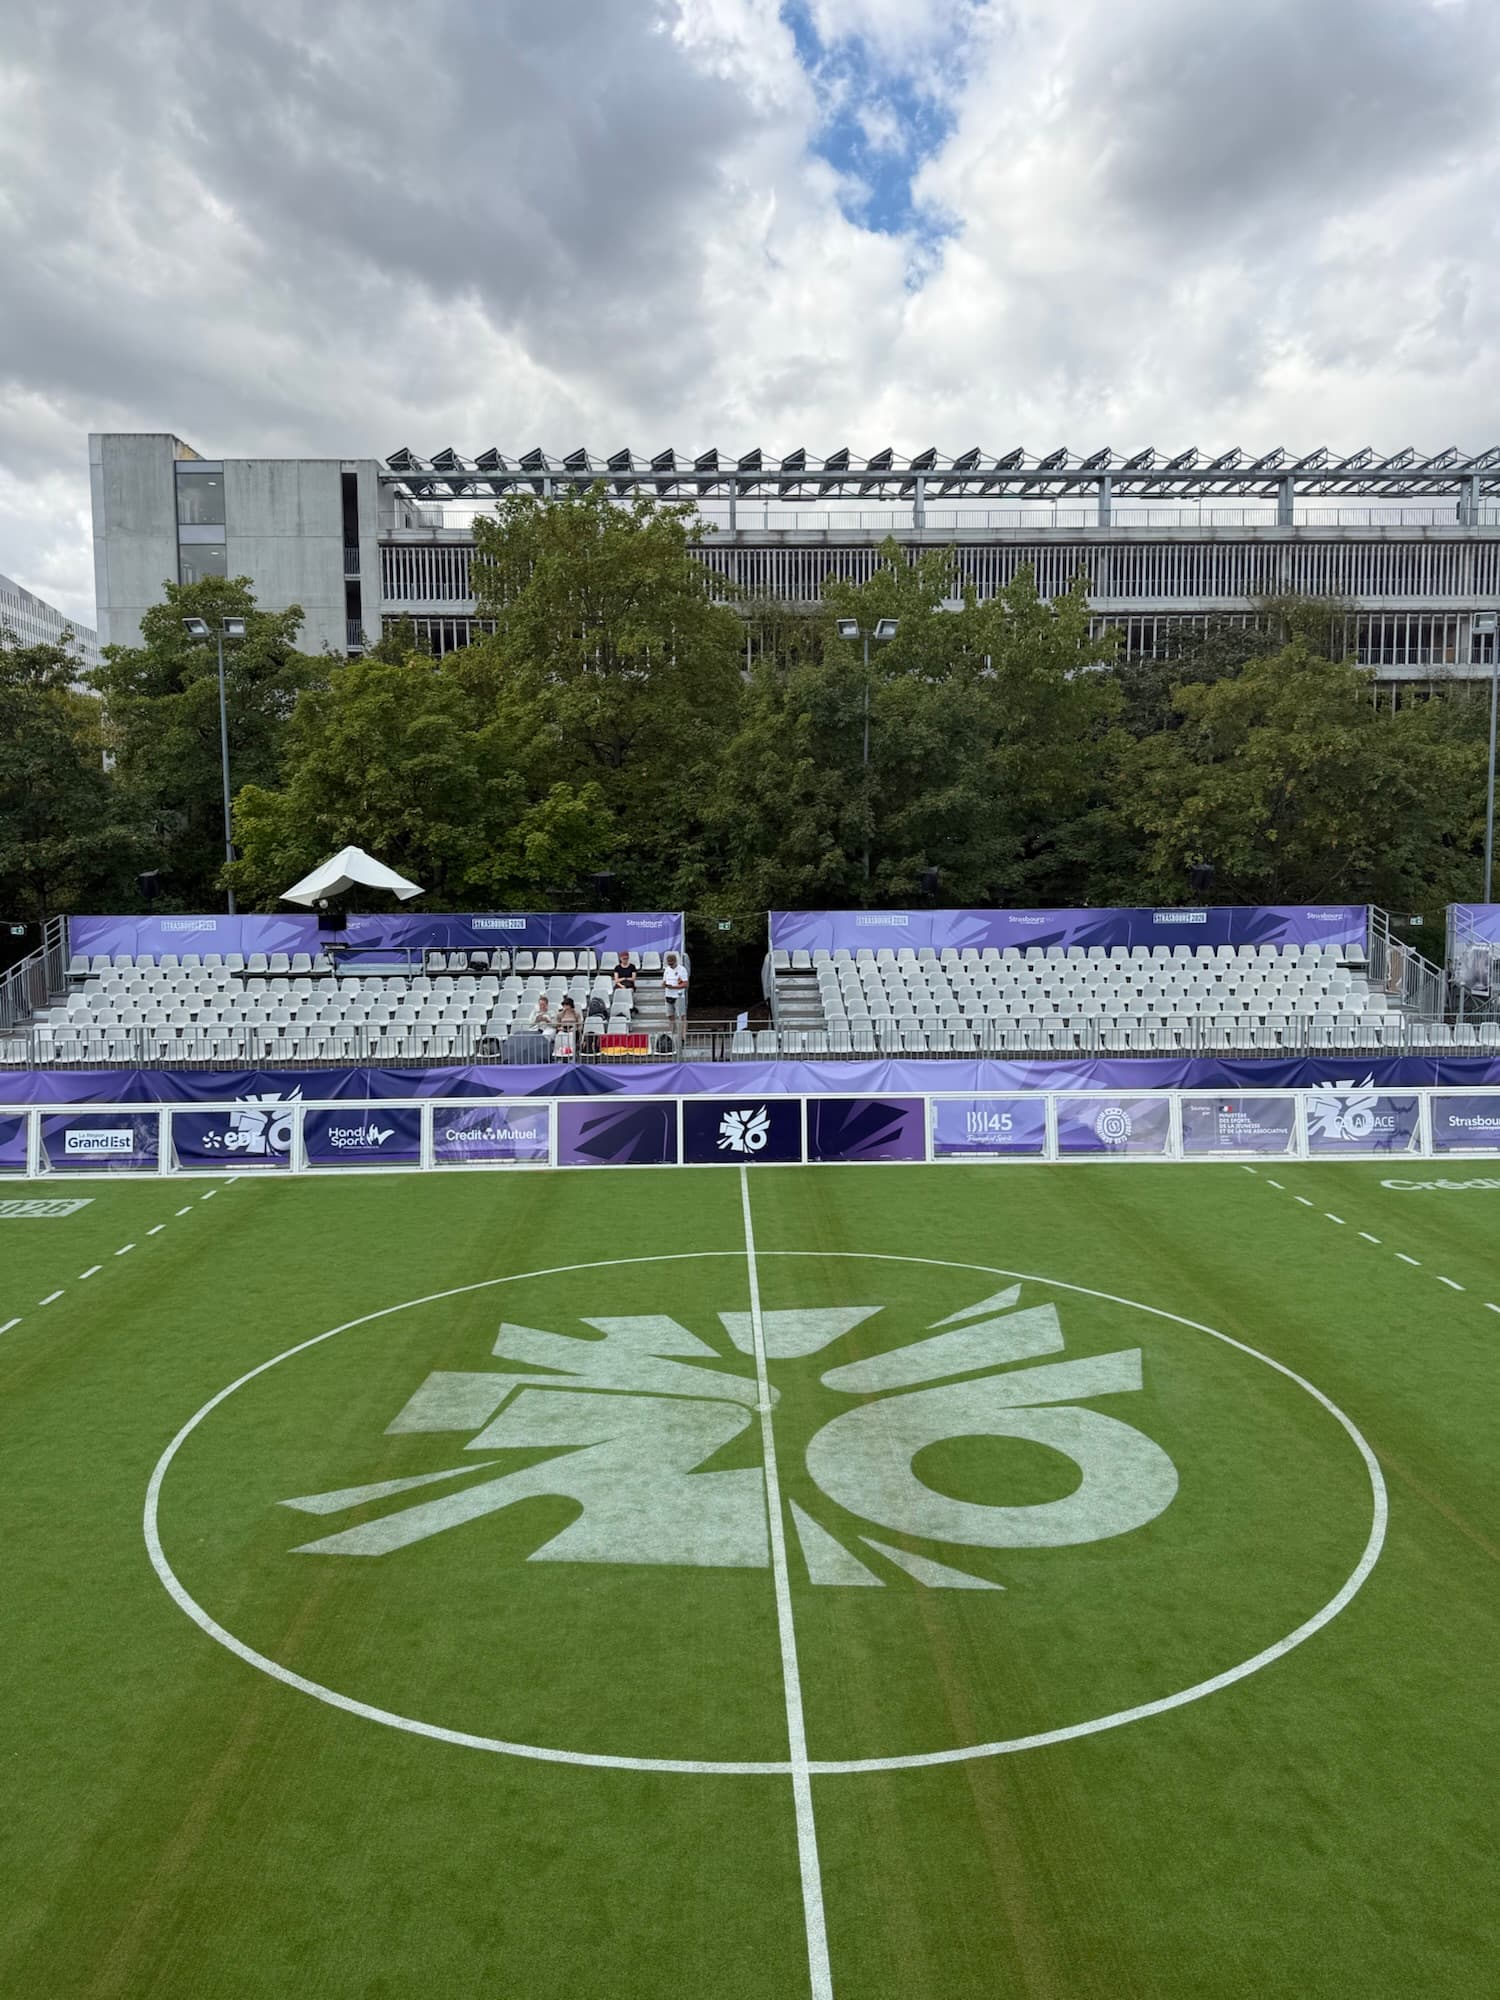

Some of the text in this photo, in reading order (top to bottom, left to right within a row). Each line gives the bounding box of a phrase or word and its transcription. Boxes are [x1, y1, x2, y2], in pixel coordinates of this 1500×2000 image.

[328, 1126, 366, 1137] Handi
[496, 1128, 537, 1140] Mutuel
[68, 1136, 131, 1148] Grand Est
[331, 1136, 365, 1149] Sport
[0, 1200, 77, 1216] 026
